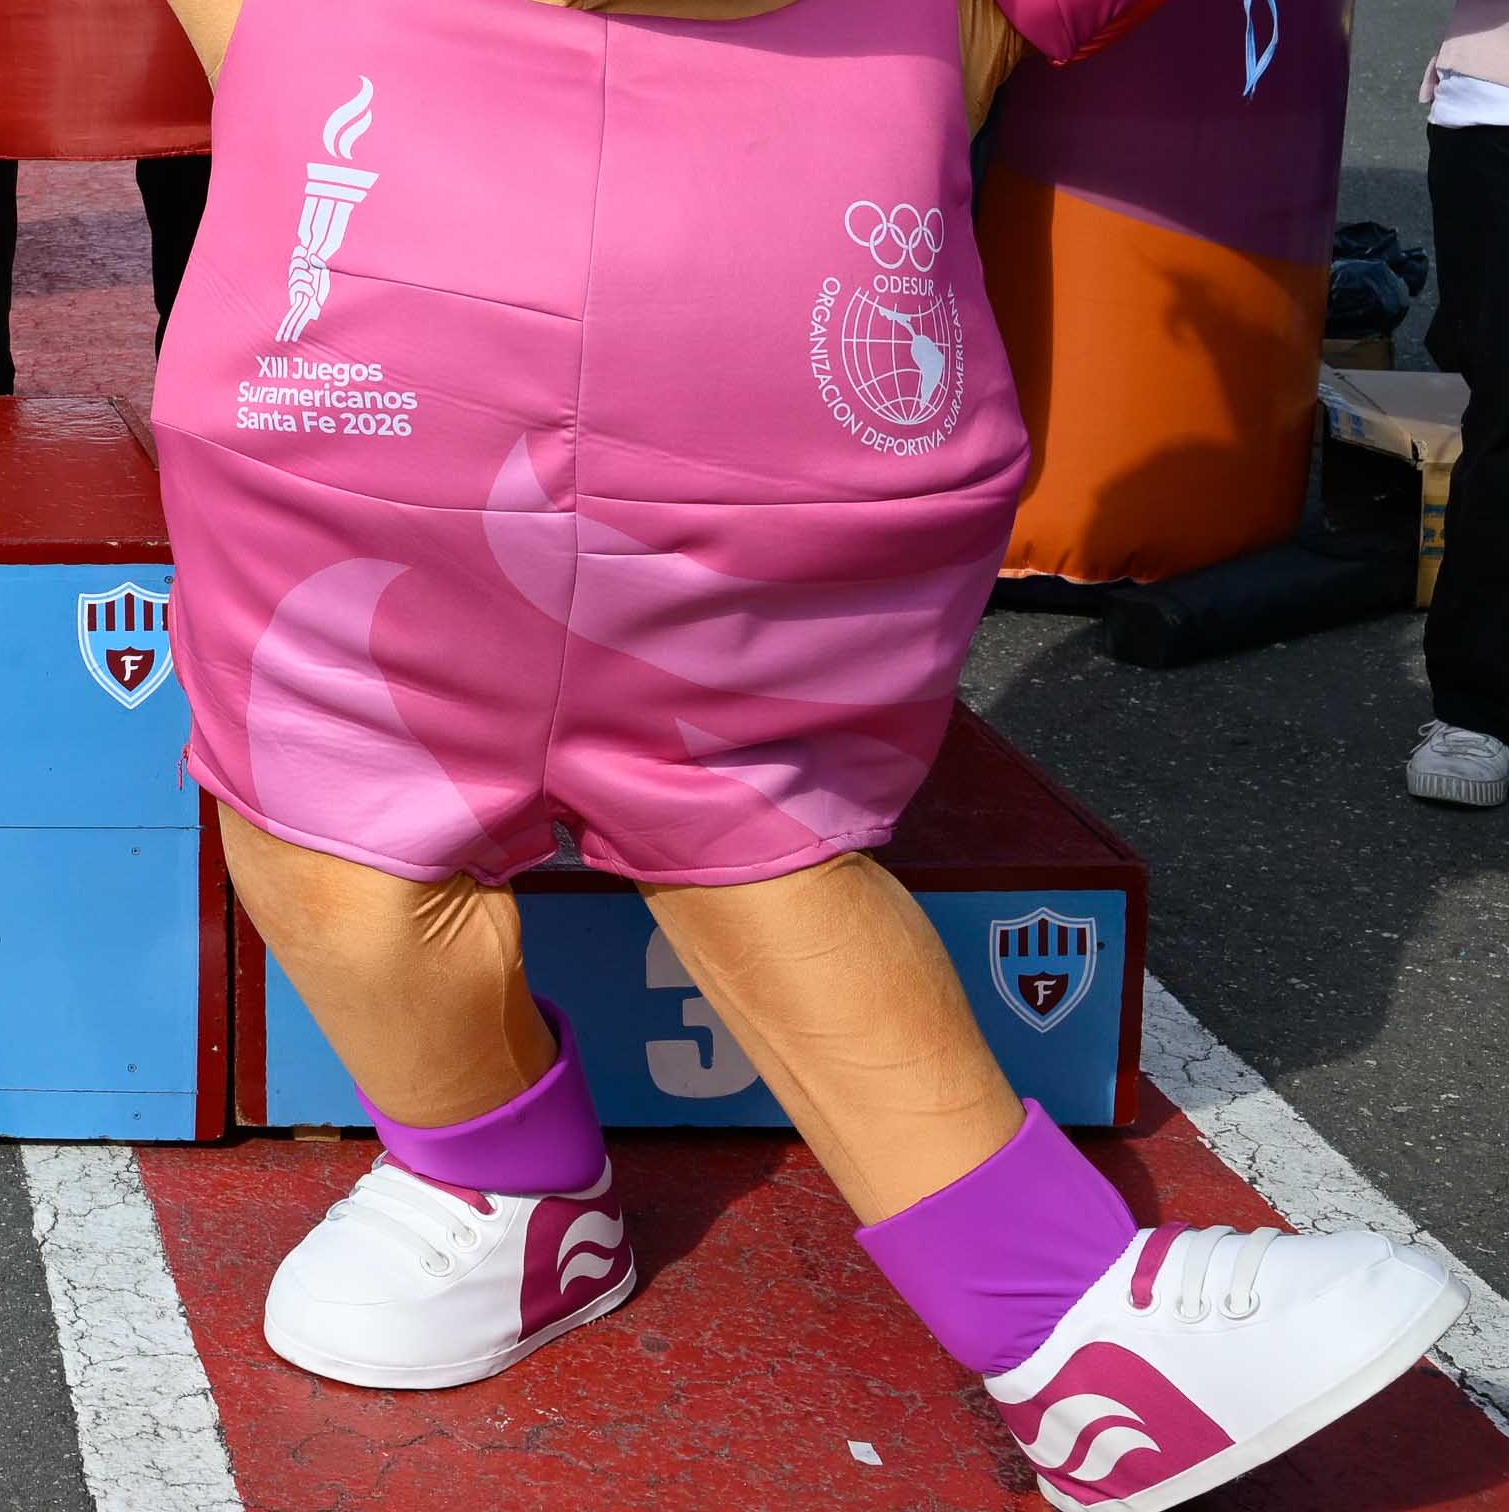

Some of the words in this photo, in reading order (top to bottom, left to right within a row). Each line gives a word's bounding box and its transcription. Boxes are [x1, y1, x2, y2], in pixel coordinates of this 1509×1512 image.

[873, 274, 934, 296] ODESUR
[256, 356, 288, 378] XIII
[293, 358, 383, 384] Juegos
[809, 276, 863, 436] ORGANIZACION
[860, 426, 946, 457] DEPORTIVA
[943, 283, 965, 435] SURAMERICANA
[237, 380, 418, 410] Suramericanos
[236, 406, 297, 433] Santa
[302, 411, 336, 434] Fe
[342, 413, 413, 437] 2026
